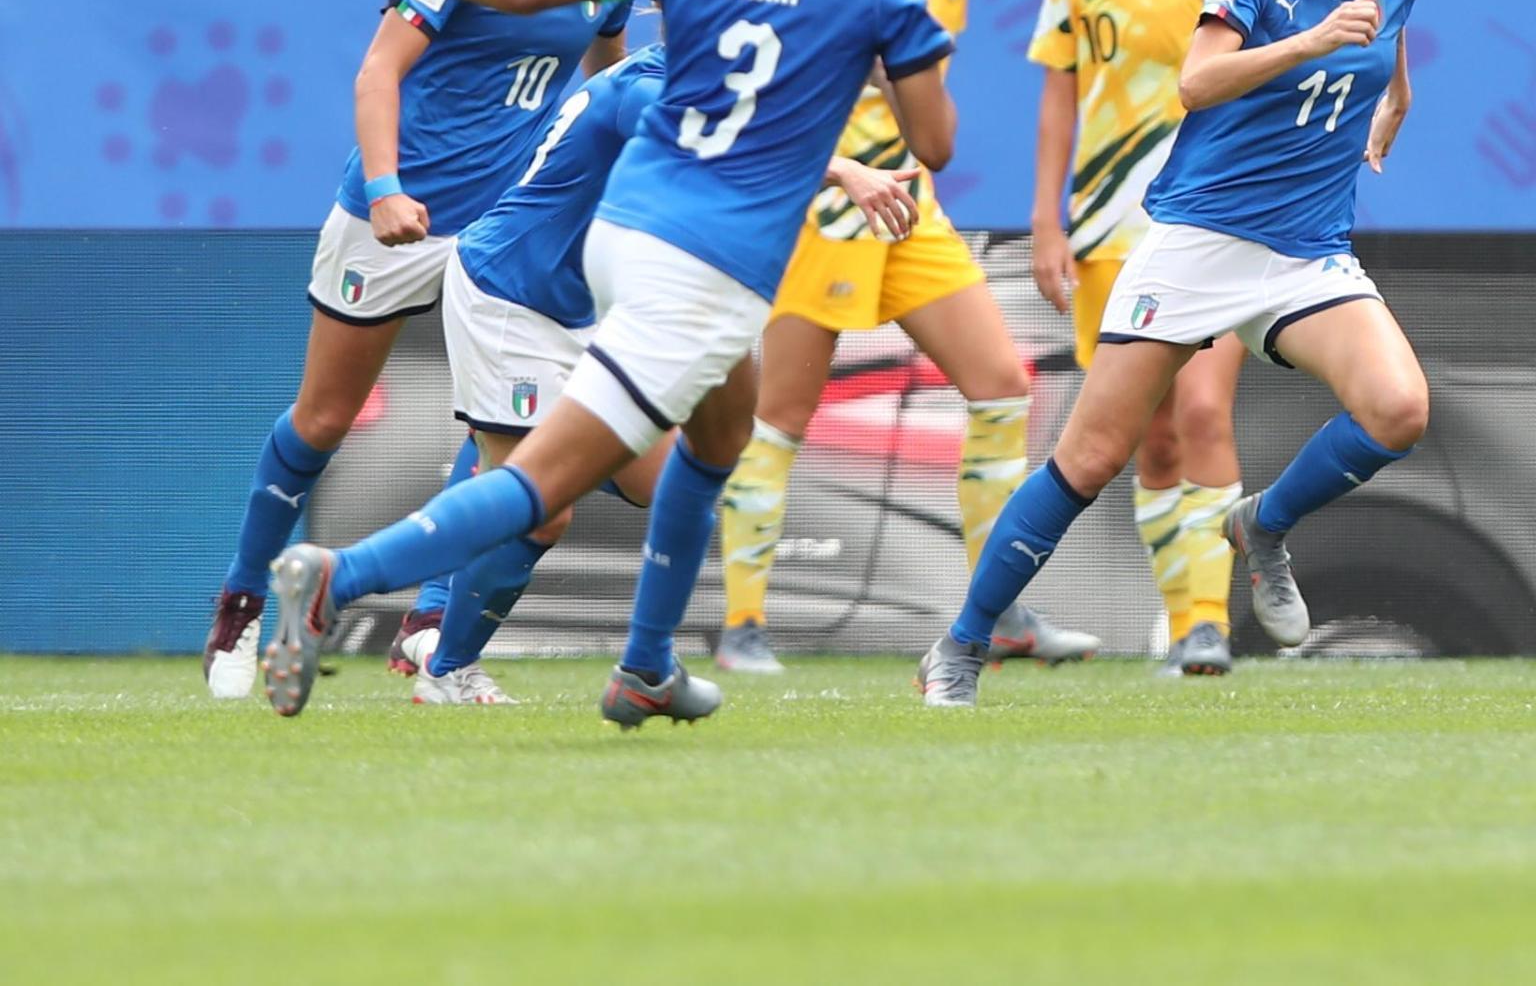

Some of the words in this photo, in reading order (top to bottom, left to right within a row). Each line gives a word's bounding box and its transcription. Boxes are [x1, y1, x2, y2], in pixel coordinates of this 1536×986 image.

[1076, 11, 1118, 65] 10
[504, 54, 560, 112] 10
[677, 18, 782, 160] 3
[1295, 69, 1355, 133] 11
